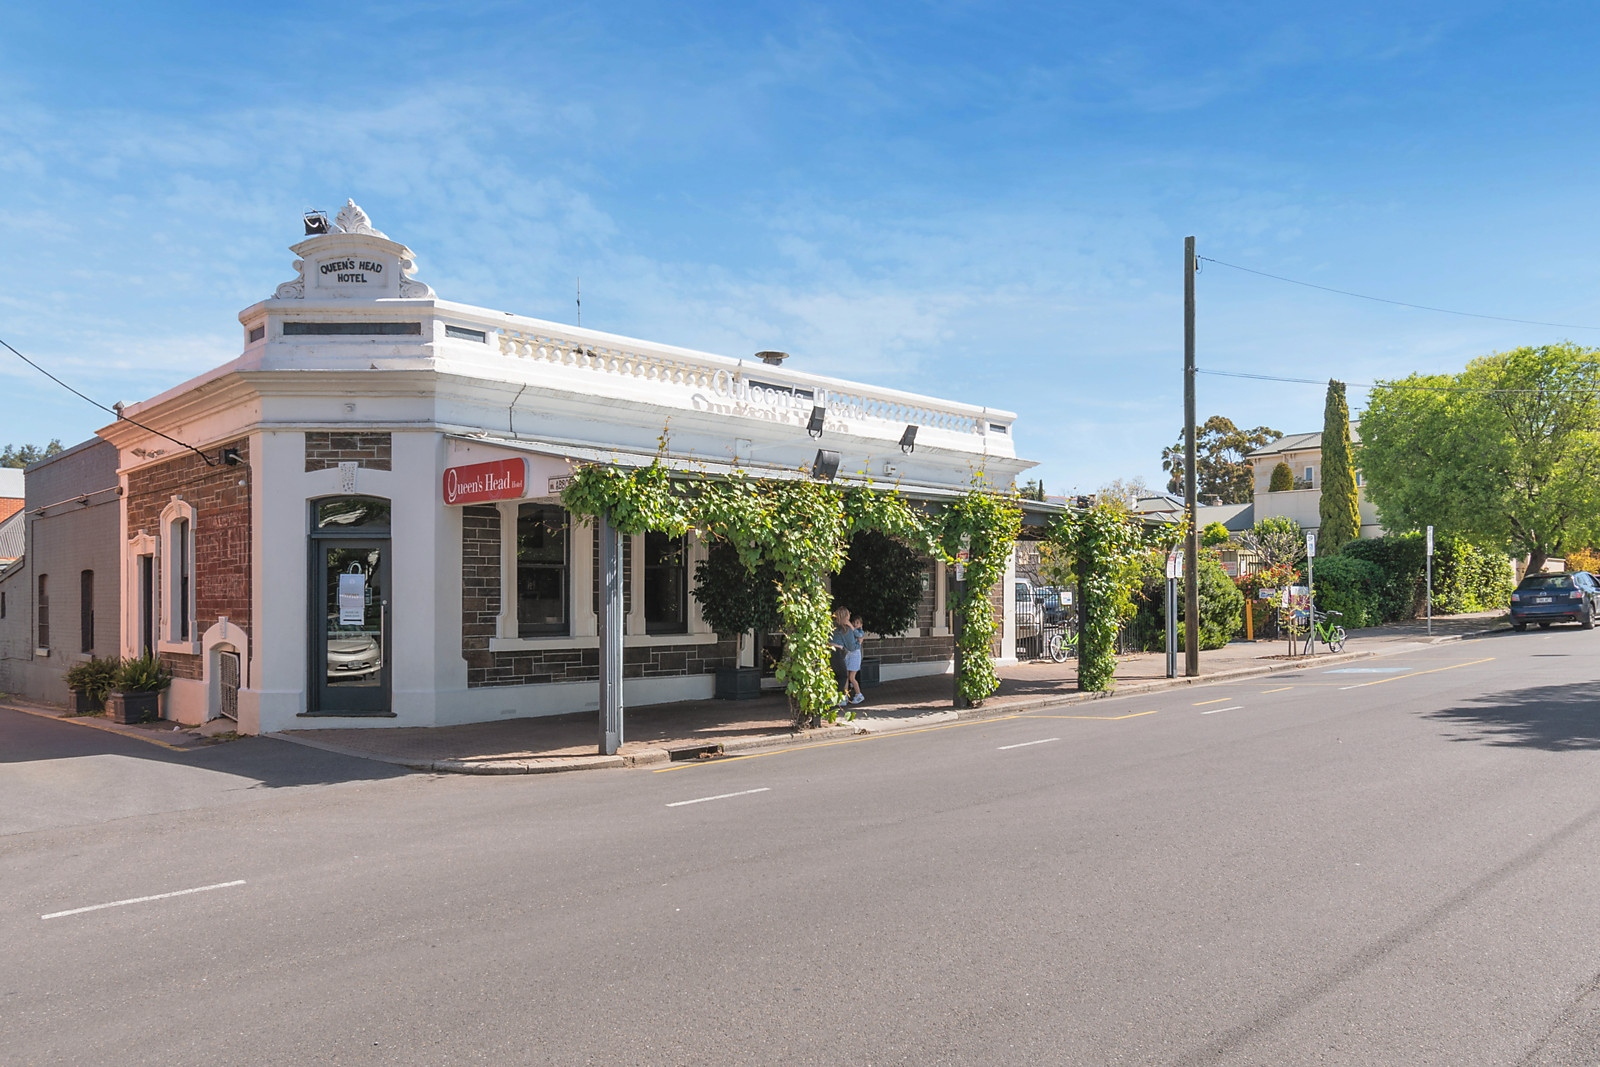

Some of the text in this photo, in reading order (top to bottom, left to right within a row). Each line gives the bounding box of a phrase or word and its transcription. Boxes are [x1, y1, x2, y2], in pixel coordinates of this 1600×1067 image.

[320, 258, 383, 274] QUEEN'S HEAD
[338, 274, 367, 283] HOTEL
[712, 368, 804, 408] Queen's
[447, 468, 523, 503] Queen's Head Hotel
